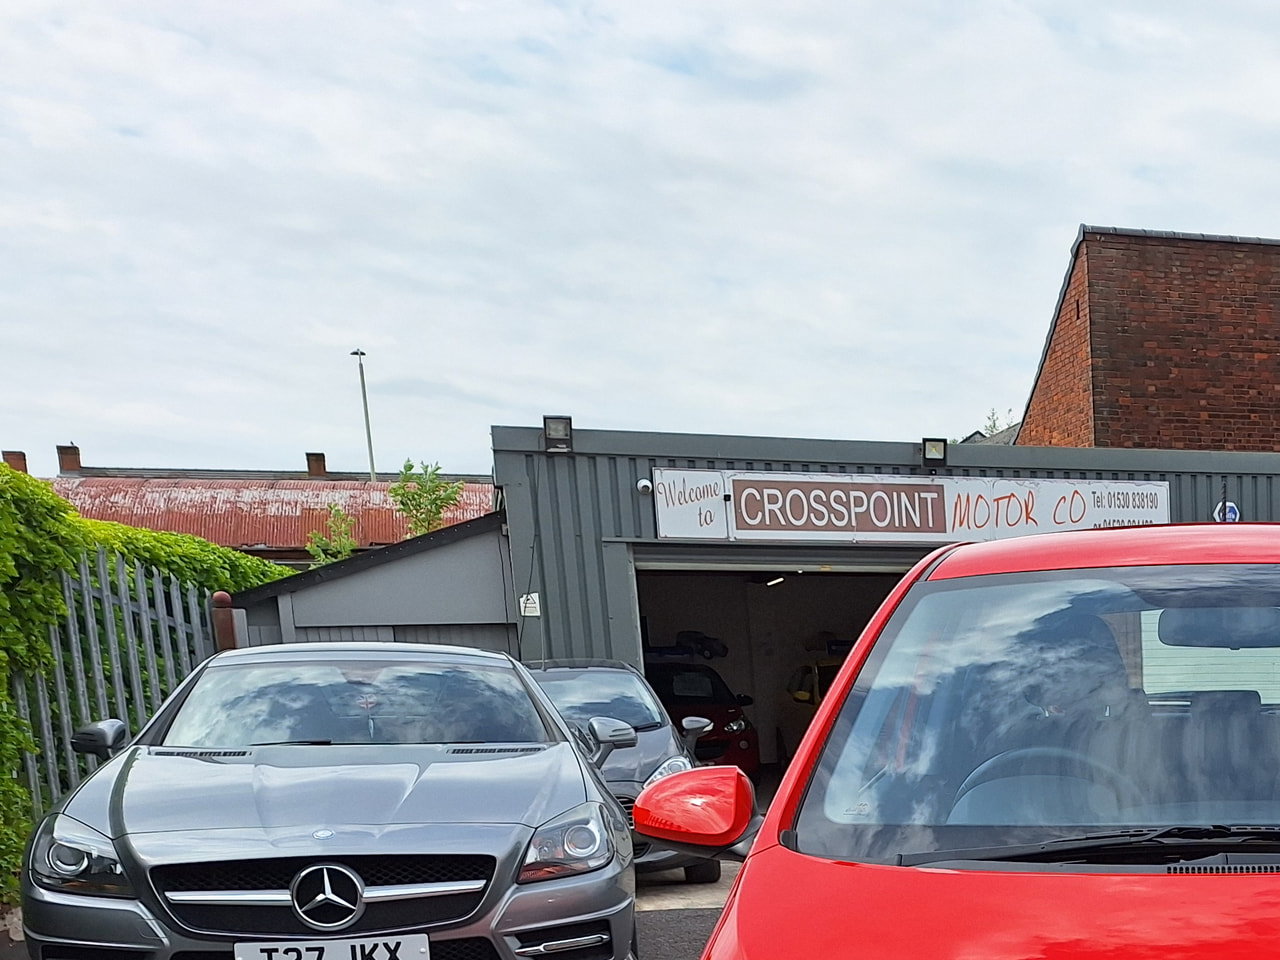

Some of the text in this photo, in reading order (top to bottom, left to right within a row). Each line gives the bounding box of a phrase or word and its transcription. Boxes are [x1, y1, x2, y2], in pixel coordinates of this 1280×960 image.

[657, 477, 720, 509] Welcome
[1091, 491, 1159, 509] Tel: 01530 838190
[698, 506, 716, 527] to
[740, 487, 1087, 533] CROSSPOINT MOTOR CO
